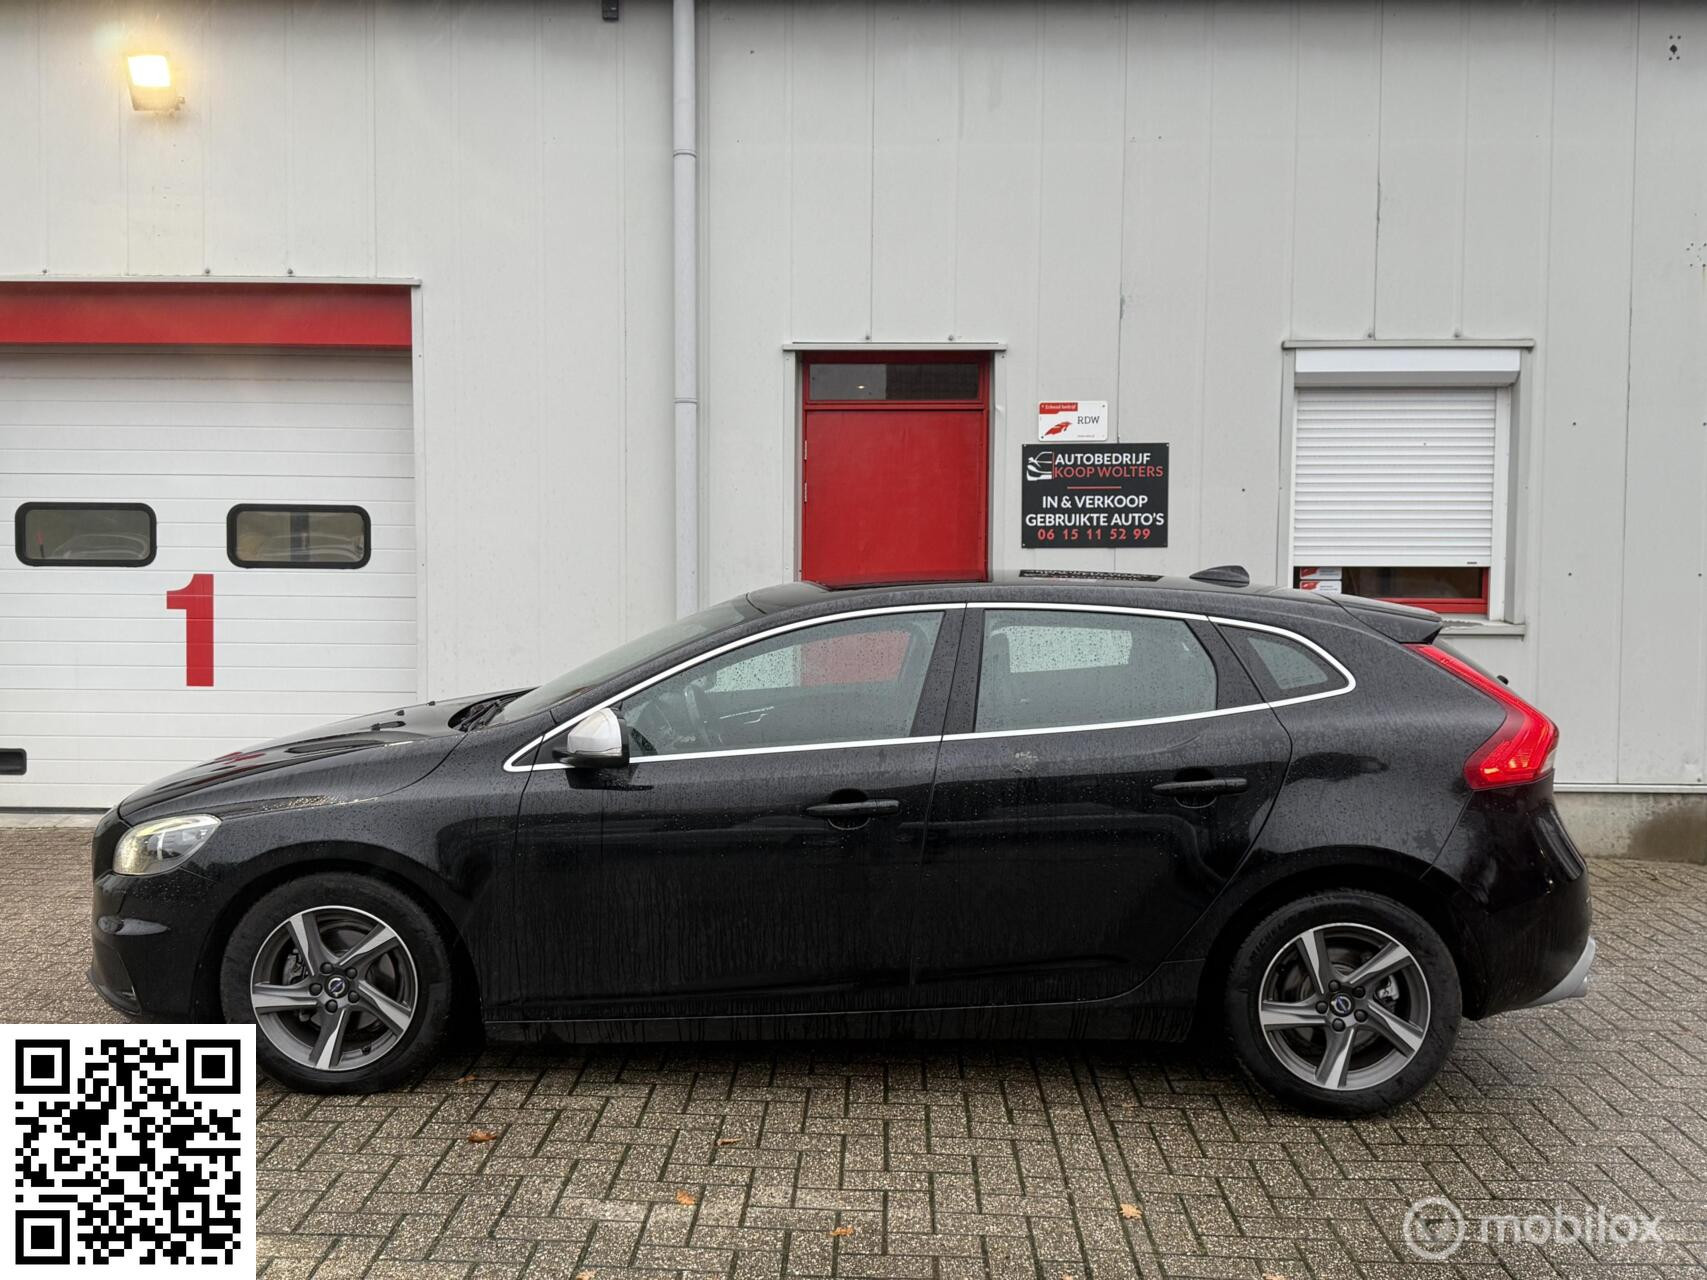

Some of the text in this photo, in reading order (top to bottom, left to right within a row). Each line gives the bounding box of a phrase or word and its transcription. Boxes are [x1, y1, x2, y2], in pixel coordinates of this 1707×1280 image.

[1077, 415, 1100, 425] RDW
[1055, 453, 1151, 465] AUTOBEDRIJF
[1054, 466, 1164, 478] KOOP WOLTERS
[1042, 495, 1148, 509] IN & VERKOOP
[1025, 513, 1165, 527] GEBRUIKTE AUTO'S
[1037, 528, 1151, 540] 06 15 11 52 99
[166, 573, 214, 687] 1
